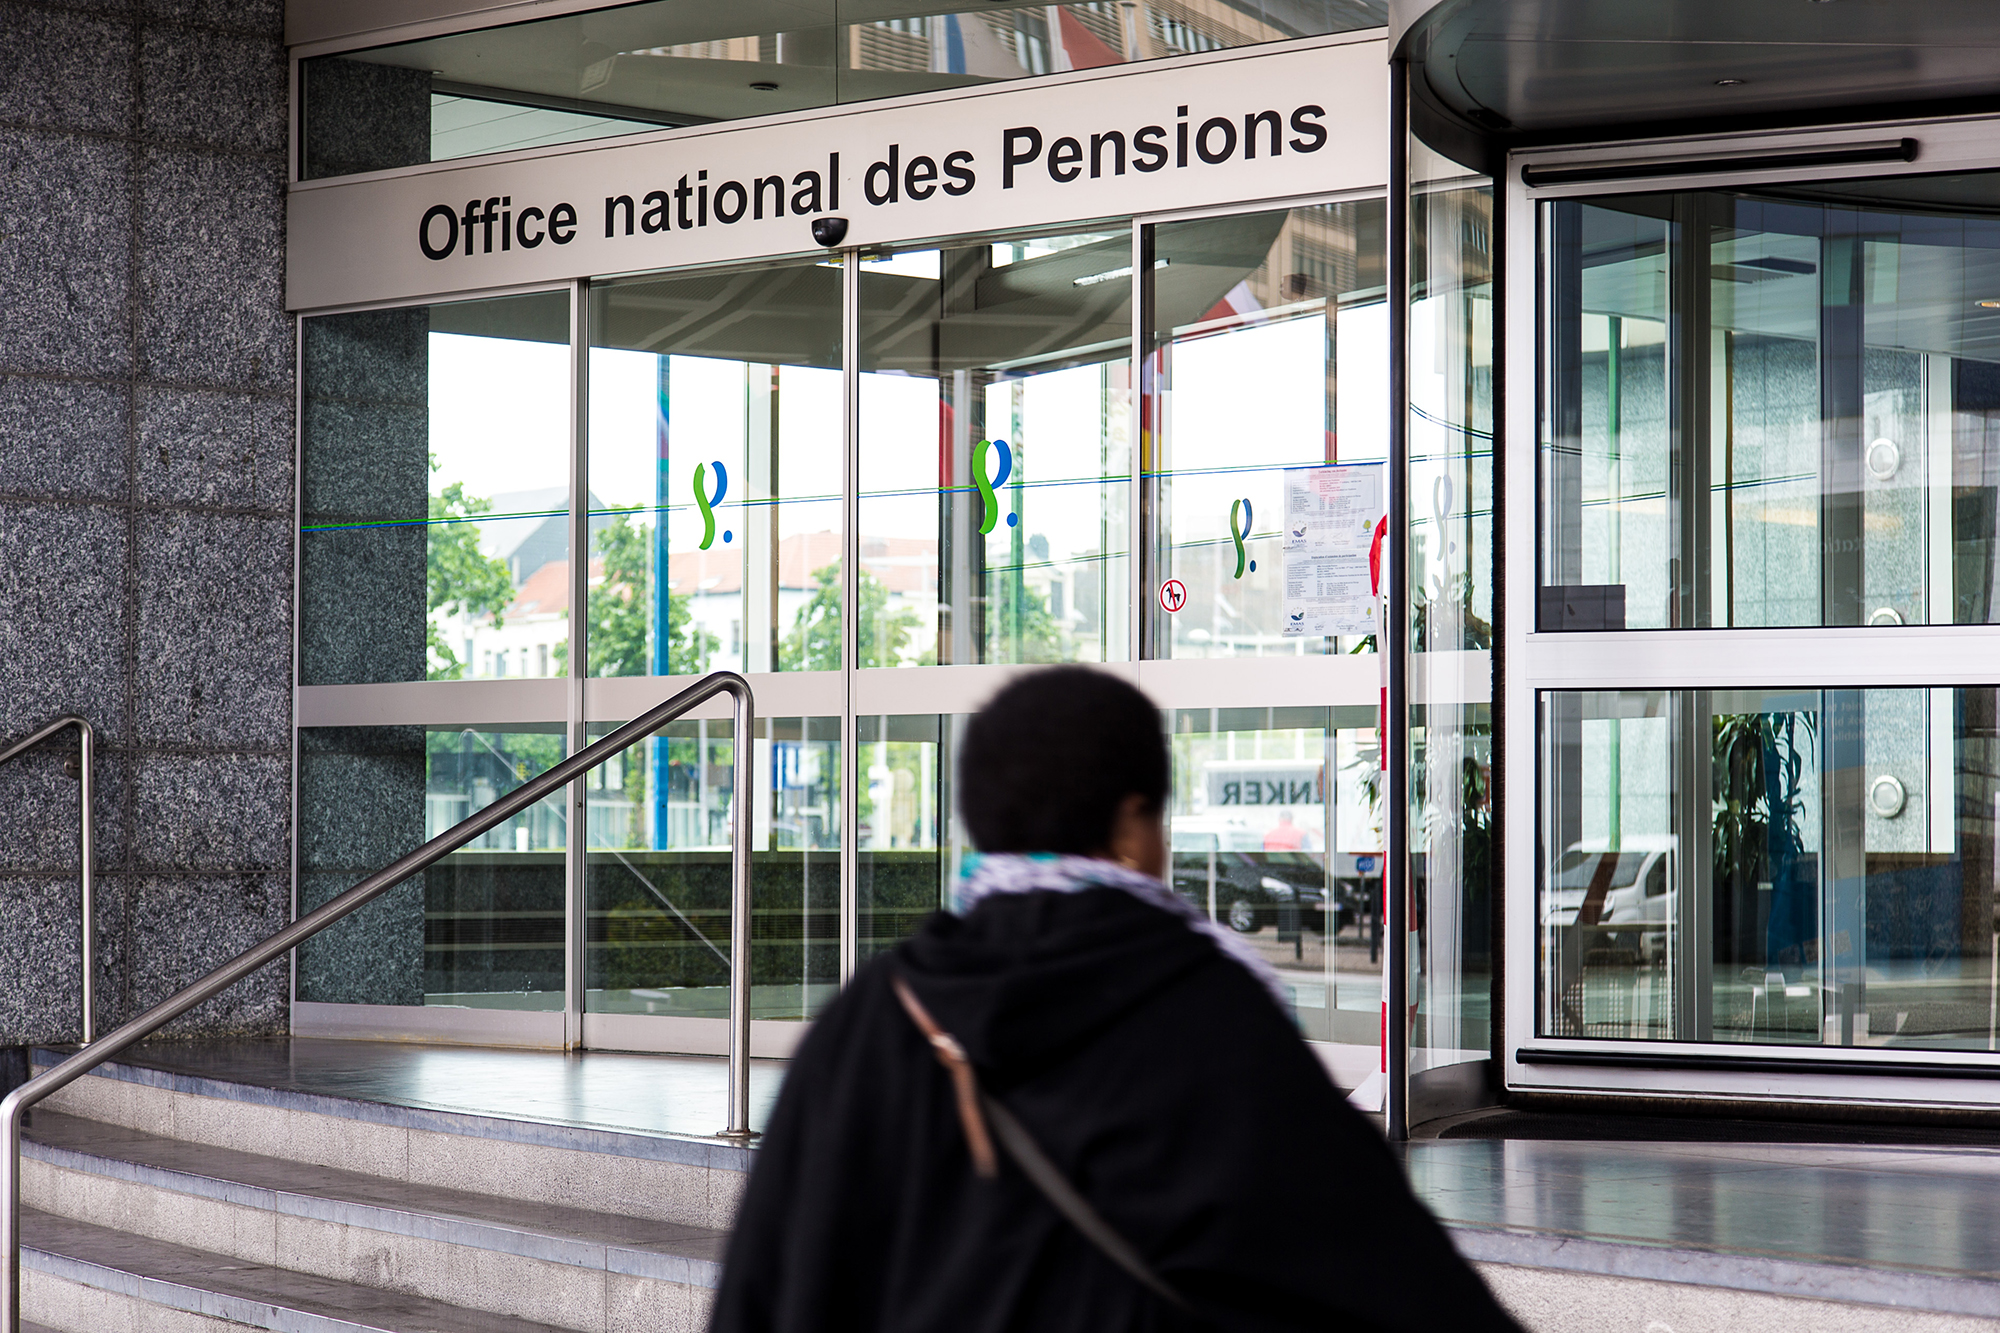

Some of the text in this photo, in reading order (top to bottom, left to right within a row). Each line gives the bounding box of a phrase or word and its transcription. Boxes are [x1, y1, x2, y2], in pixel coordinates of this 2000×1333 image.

[418, 104, 1328, 261] Office national des Pensions
